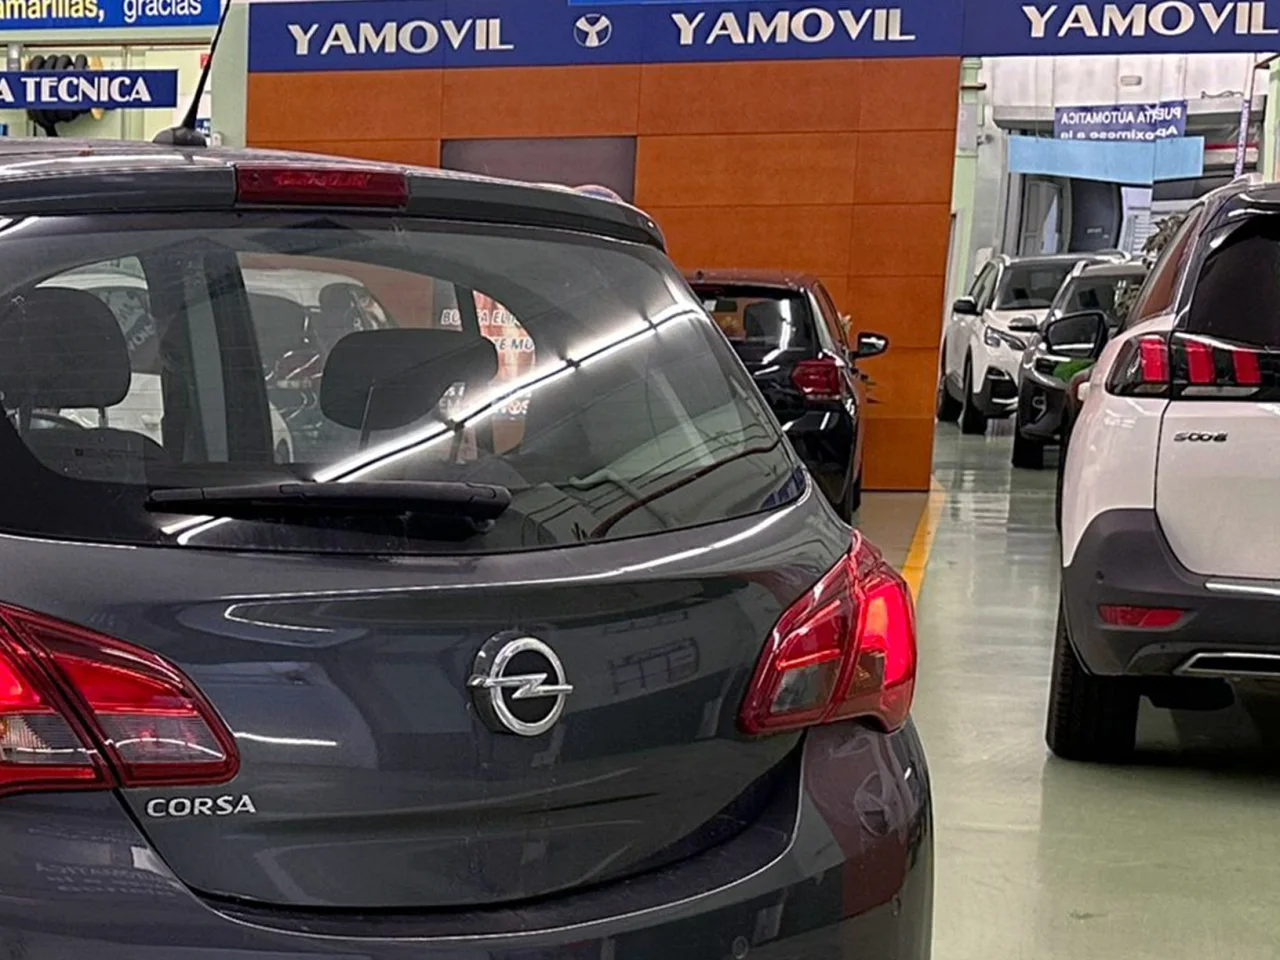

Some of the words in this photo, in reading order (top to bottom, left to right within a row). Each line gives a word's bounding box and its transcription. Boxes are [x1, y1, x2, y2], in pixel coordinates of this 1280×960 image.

[123, 0, 202, 23] gracias
[671, 8, 916, 45] YAMOVIL
[1021, 0, 1279, 38] YAMOVIL
[287, 17, 515, 56] YAMOVIL
[21, 77, 151, 103] TECNICA
[146, 794, 257, 817] CORSA
